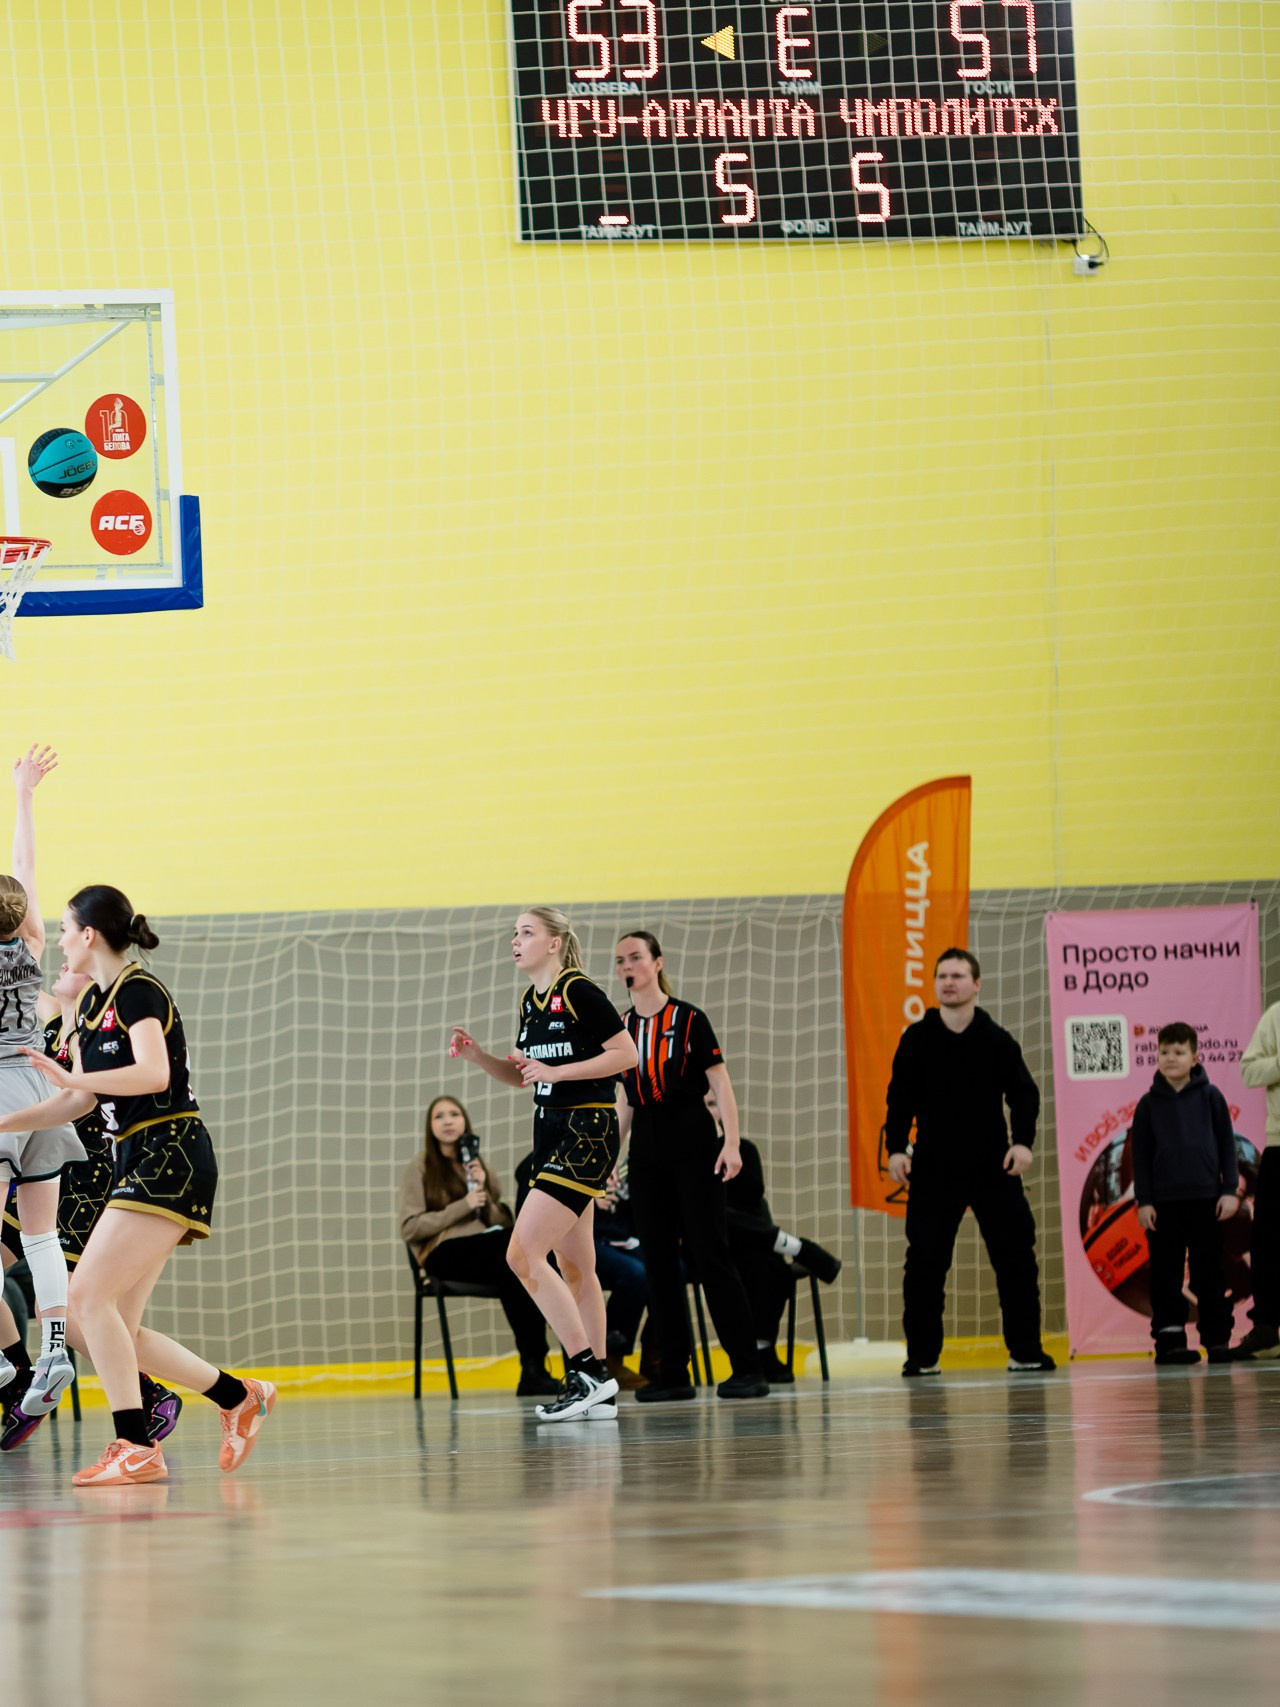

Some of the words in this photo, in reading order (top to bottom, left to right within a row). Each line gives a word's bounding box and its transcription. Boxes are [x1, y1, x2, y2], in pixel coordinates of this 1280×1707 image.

[568, 0, 660, 79] 53
[949, 0, 1039, 79] 57
[567, 82, 640, 96] ХОЗЯЕВА
[776, 81, 821, 96] ТАЙМ
[963, 80, 1016, 96] ГОСТИ
[541, 98, 816, 138] ЧГУ-АТЛАНТА
[714, 152, 756, 225] 5
[850, 151, 891, 223] 5
[578, 224, 656, 239] ТАЙМ-АУТ
[780, 219, 831, 235] ФОЛЫ
[957, 219, 1033, 236] ТАЙМ-АУТ
[111, 432, 131, 442] ЛИГА
[98, 515, 145, 536] АСБ
[905, 840, 933, 984] ПИЦЦА
[1062, 944, 1158, 969] Просто
[1163, 940, 1241, 961] начни
[1063, 974, 1078, 992] в
[1082, 969, 1150, 995] Додо
